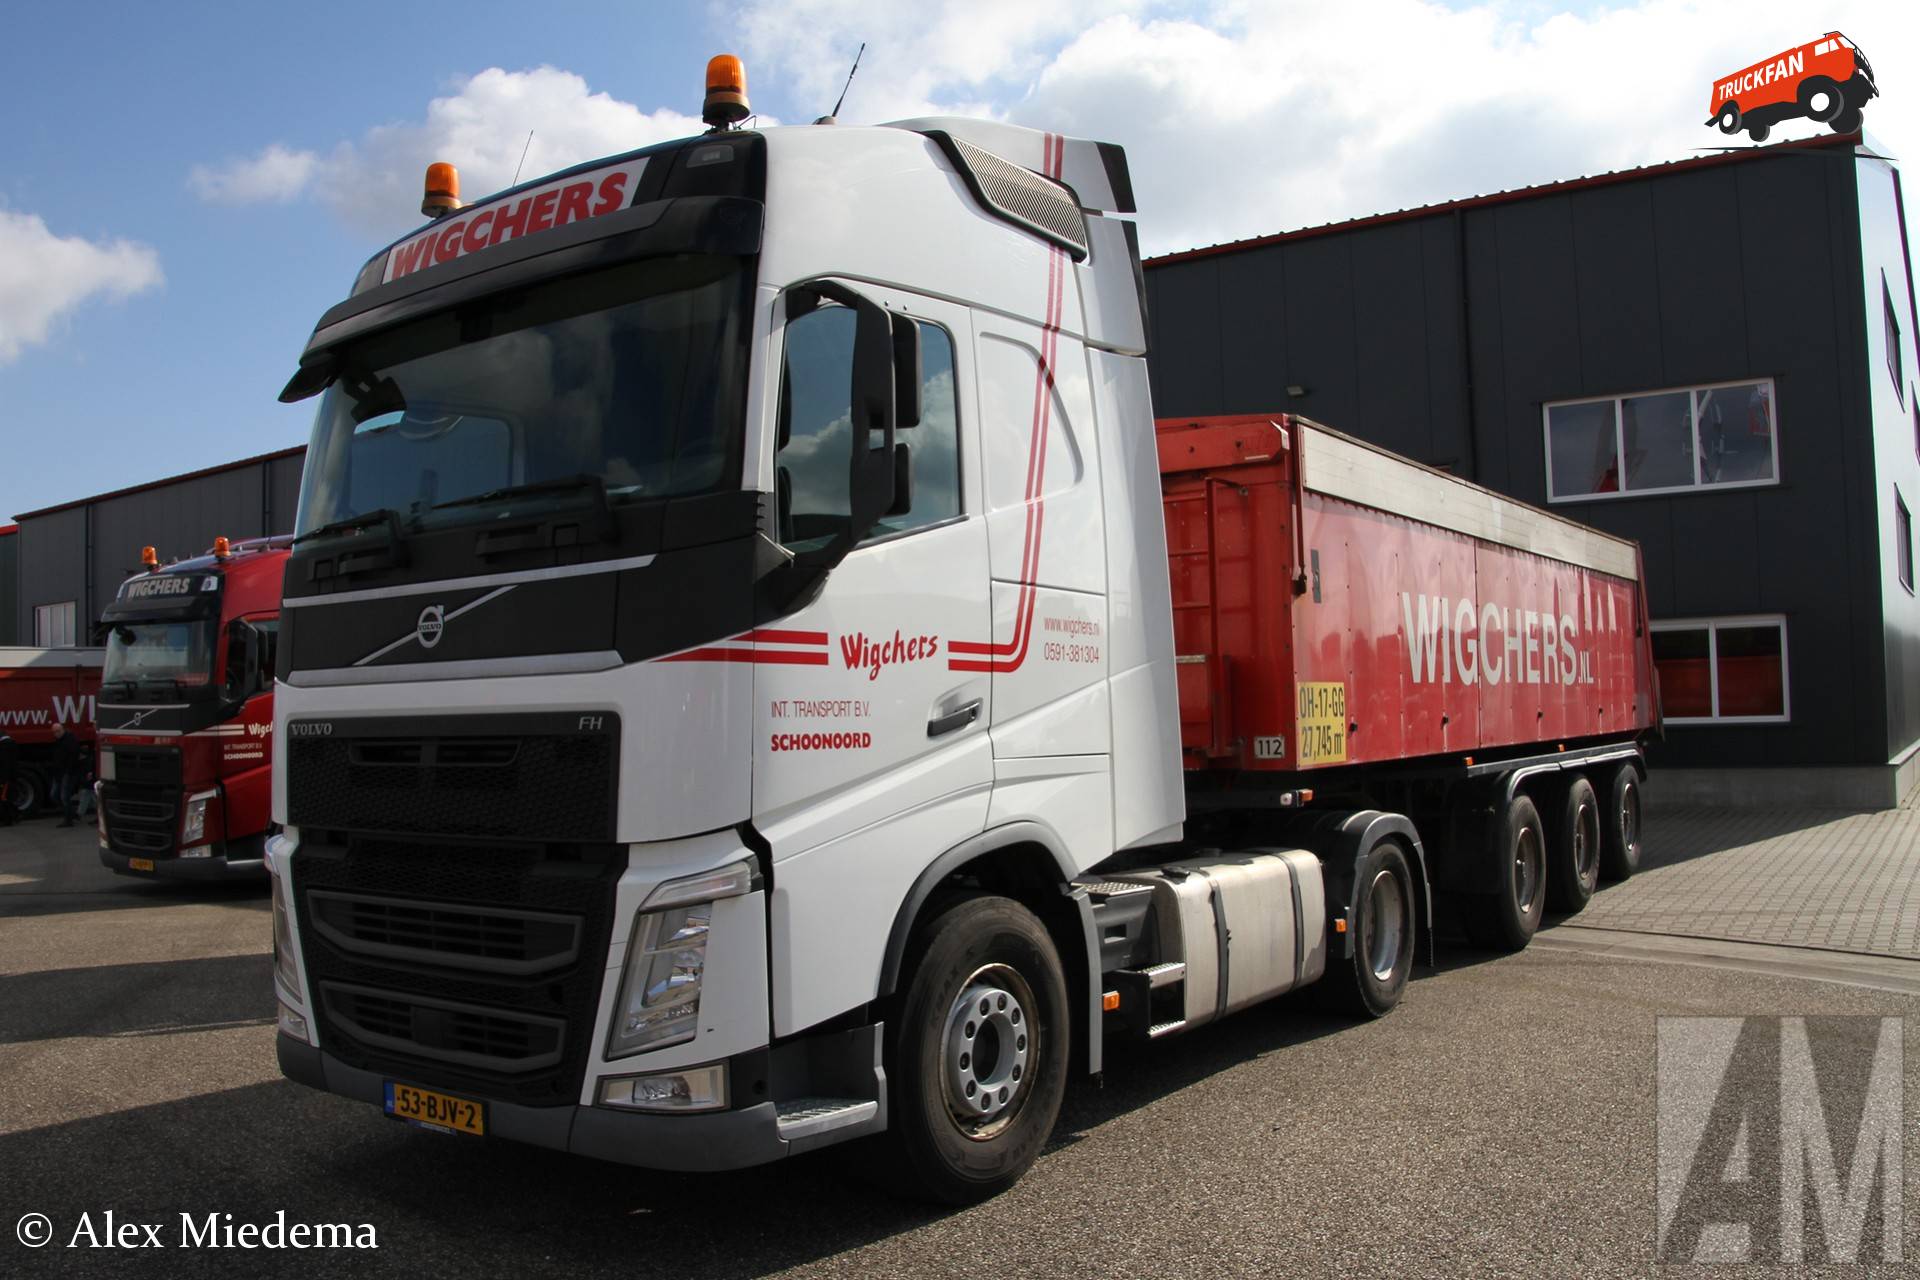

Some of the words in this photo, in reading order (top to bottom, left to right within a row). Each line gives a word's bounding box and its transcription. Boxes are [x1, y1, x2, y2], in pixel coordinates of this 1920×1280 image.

[391, 171, 628, 280] WIGCHERS
[127, 577, 191, 599] WIGCHERS
[418, 622, 443, 632] VOLVO
[1044, 617, 1100, 638] www.wigchers.nl
[1402, 592, 1594, 687] WIGCHERS.NL
[840, 629, 938, 681] Wigchers
[1044, 642, 1099, 664] 0591-381304
[771, 702, 790, 718] INT.
[792, 701, 852, 718] TRANSPORT
[855, 701, 871, 717] B.V.
[1300, 687, 1344, 718] OH-17-GG
[291, 723, 332, 736] VOLVO
[578, 716, 603, 730] FH
[770, 732, 871, 751] SCHOONOORD
[1258, 739, 1282, 756] 112
[1302, 725, 1332, 760] 27,745
[400, 1089, 476, 1129] 53-BJV-2
